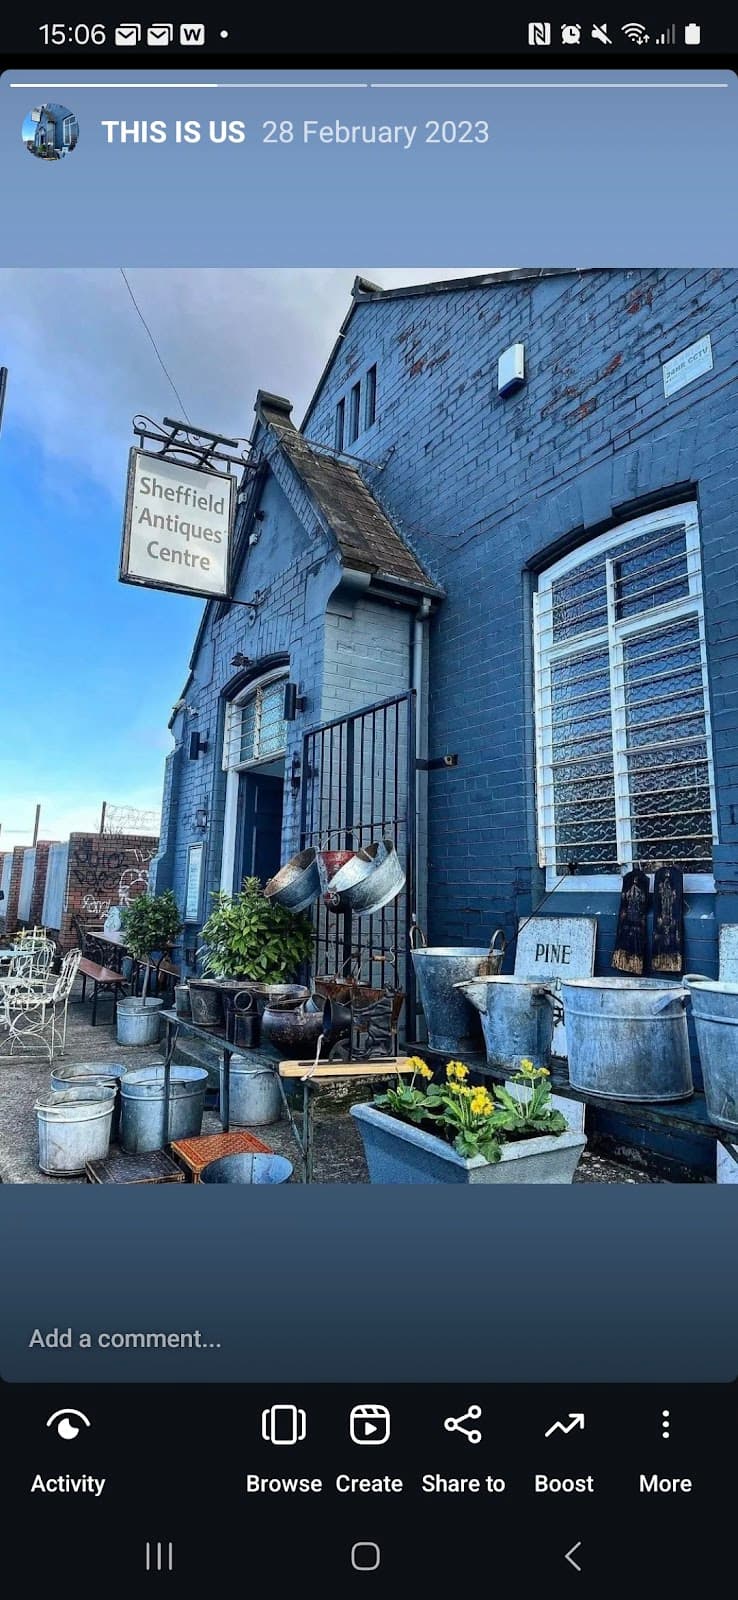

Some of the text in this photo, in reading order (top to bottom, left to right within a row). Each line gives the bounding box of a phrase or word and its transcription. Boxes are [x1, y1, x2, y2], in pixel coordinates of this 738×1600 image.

[687, 346, 708, 364] CCTV
[139, 476, 225, 516] Sheffield
[137, 507, 223, 544] Antiques
[146, 540, 211, 571] Centre
[534, 943, 571, 965] PINE
